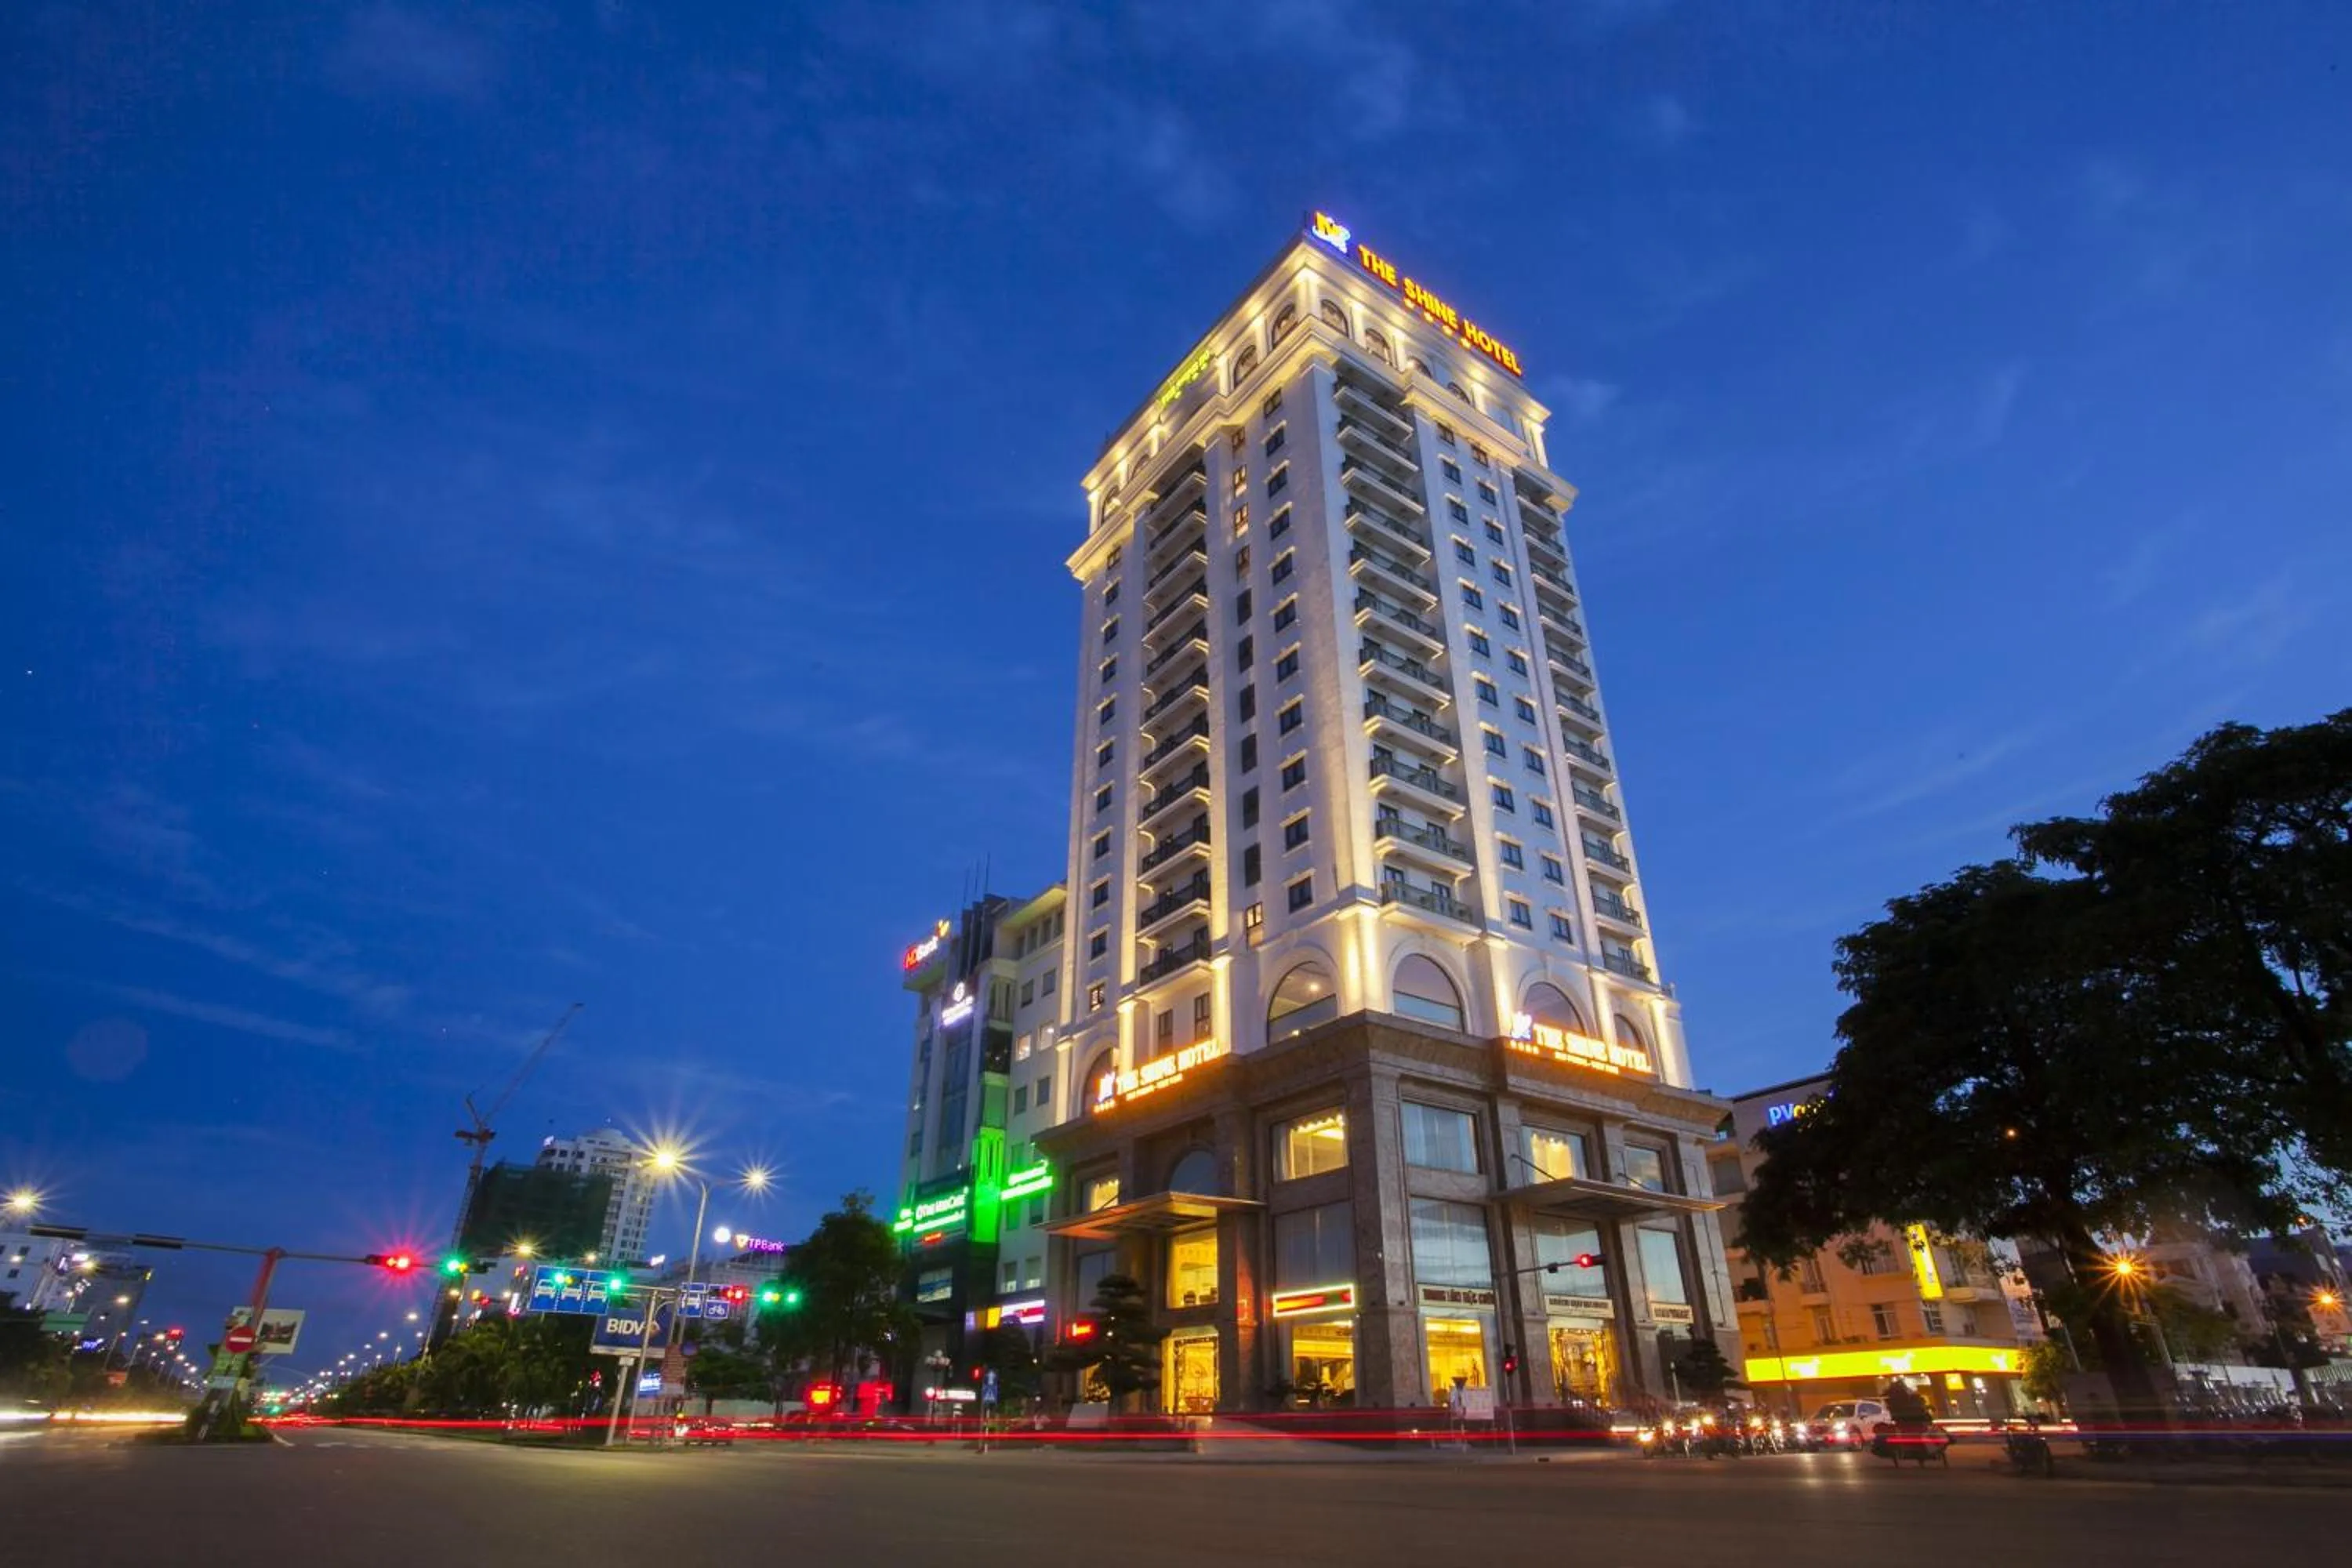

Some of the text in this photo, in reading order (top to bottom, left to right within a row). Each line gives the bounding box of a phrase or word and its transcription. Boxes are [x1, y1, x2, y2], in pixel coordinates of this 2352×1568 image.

[1357, 244, 1523, 377] THE SHINE HOTEL
[749, 1238, 785, 1252] TPBank
[606, 1318, 645, 1336] BIDV
